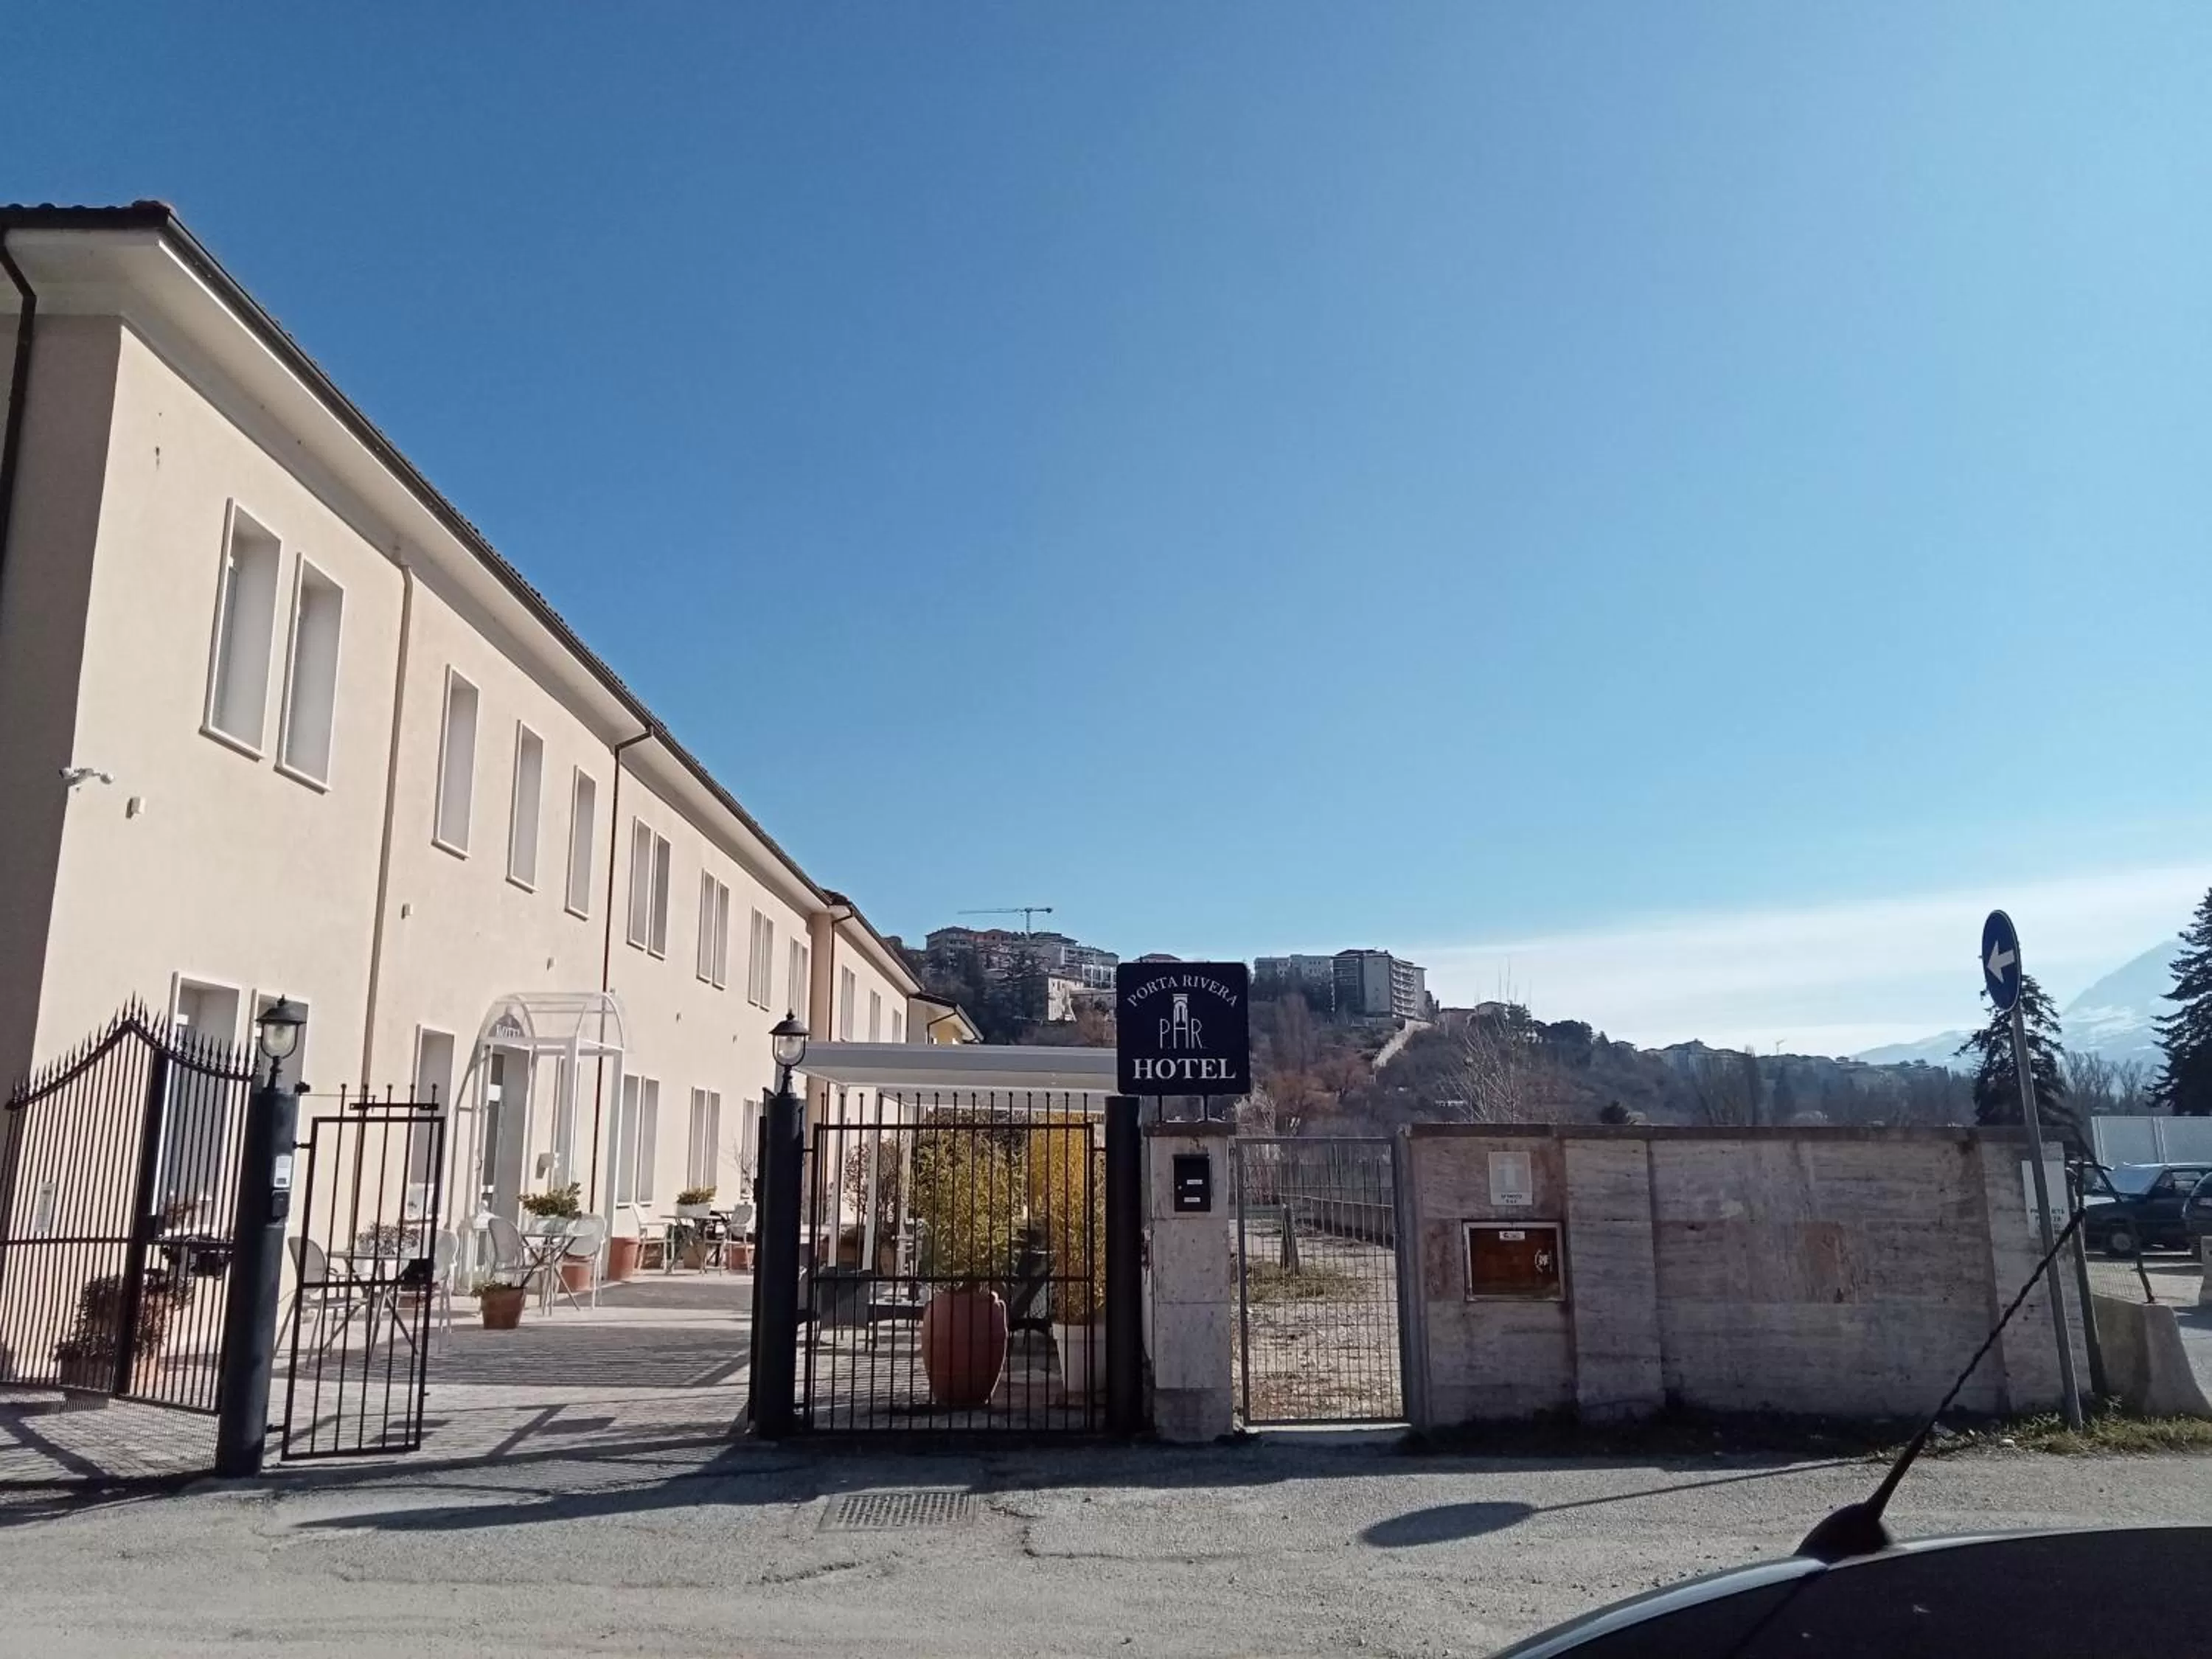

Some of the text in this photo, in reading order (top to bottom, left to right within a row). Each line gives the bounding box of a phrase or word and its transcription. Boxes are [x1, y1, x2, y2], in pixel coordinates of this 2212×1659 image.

[1127, 975, 1239, 1007] PORTA RIVERA
[1133, 1058, 1237, 1079] HOTEL
